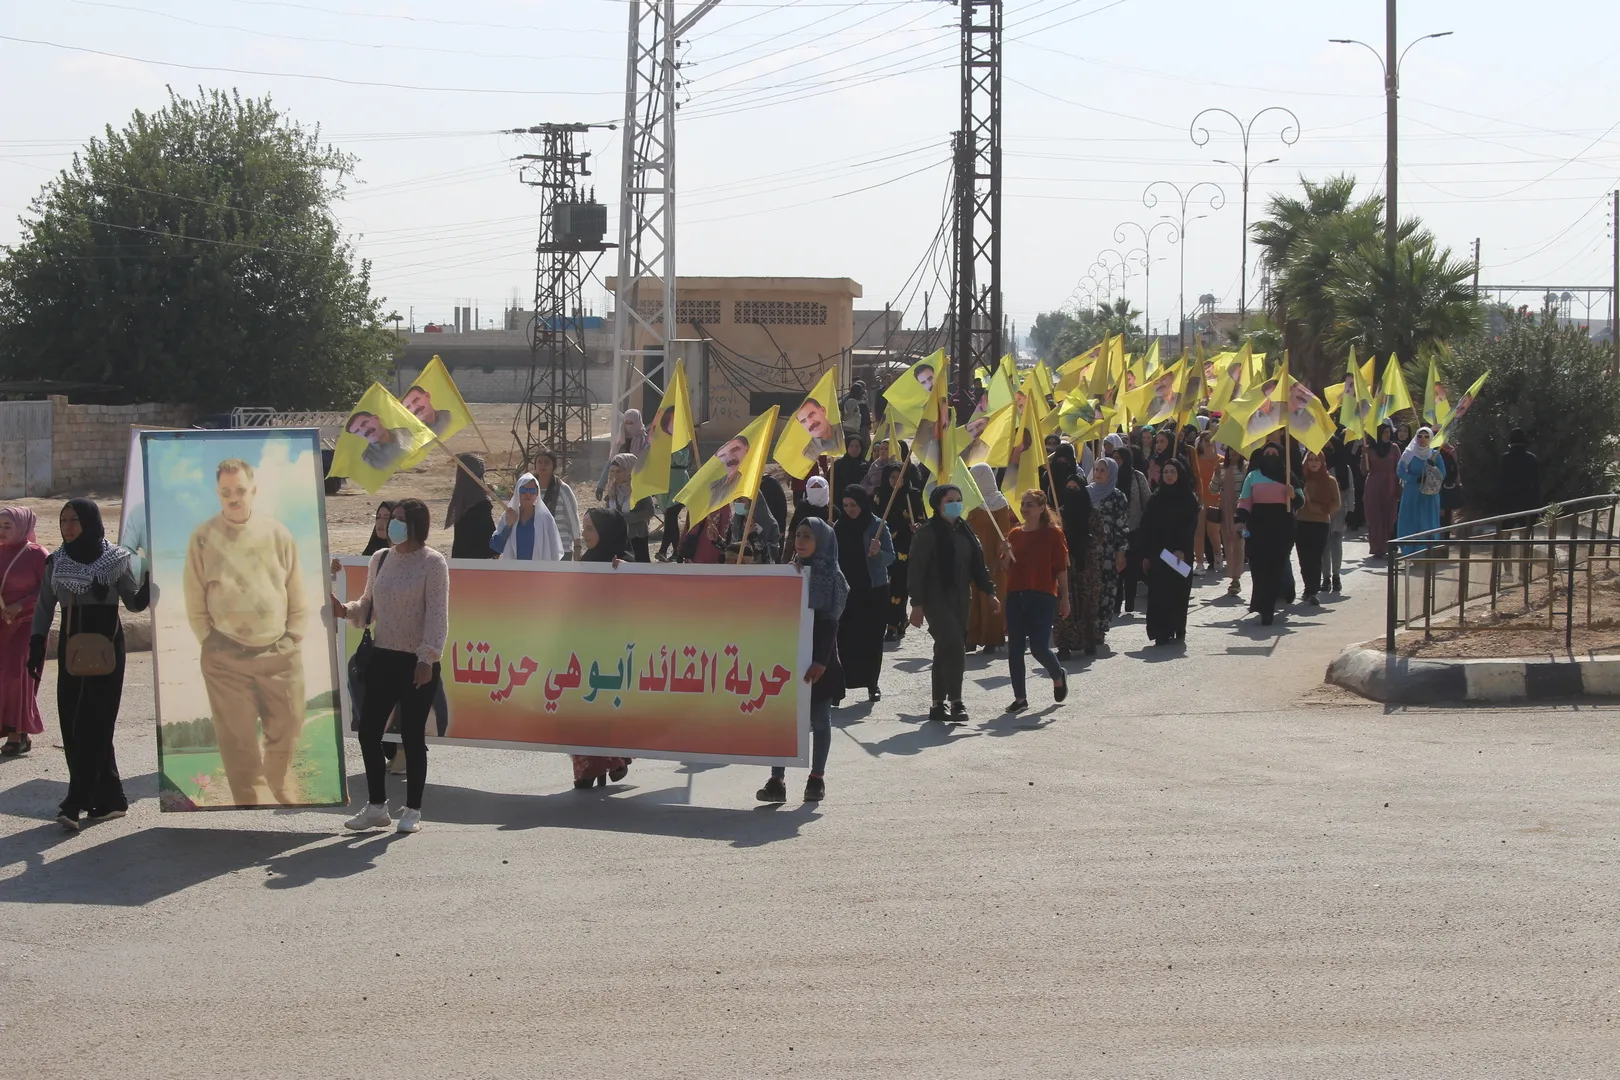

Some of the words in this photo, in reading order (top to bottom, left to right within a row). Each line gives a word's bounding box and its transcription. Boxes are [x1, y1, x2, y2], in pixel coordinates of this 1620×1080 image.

[452, 640, 539, 703] حريتنا
[544, 651, 582, 712] هي
[639, 644, 717, 693] القائد
[724, 643, 792, 714] حرية
